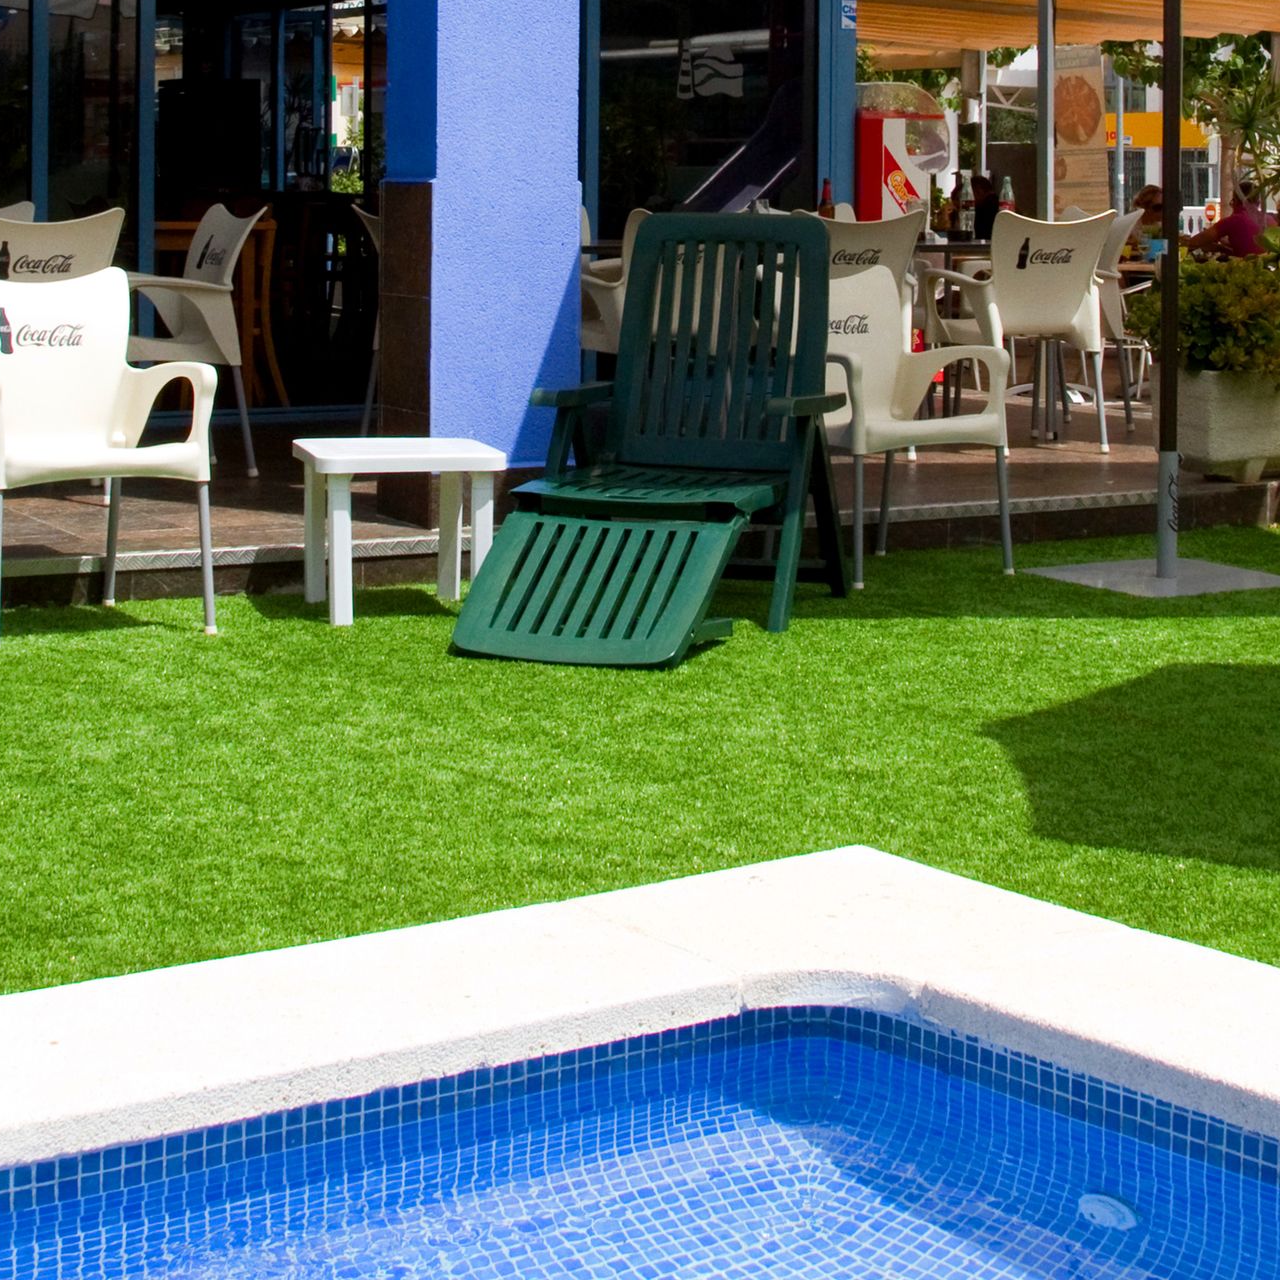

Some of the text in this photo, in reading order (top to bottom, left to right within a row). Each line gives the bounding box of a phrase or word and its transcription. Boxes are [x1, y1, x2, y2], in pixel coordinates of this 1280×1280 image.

[12, 254, 77, 275] Coca-Cola
[832, 248, 882, 266] Coca-Cola
[1030, 248, 1076, 265] Coca-Cola
[16, 324, 86, 348] Coca-Cola
